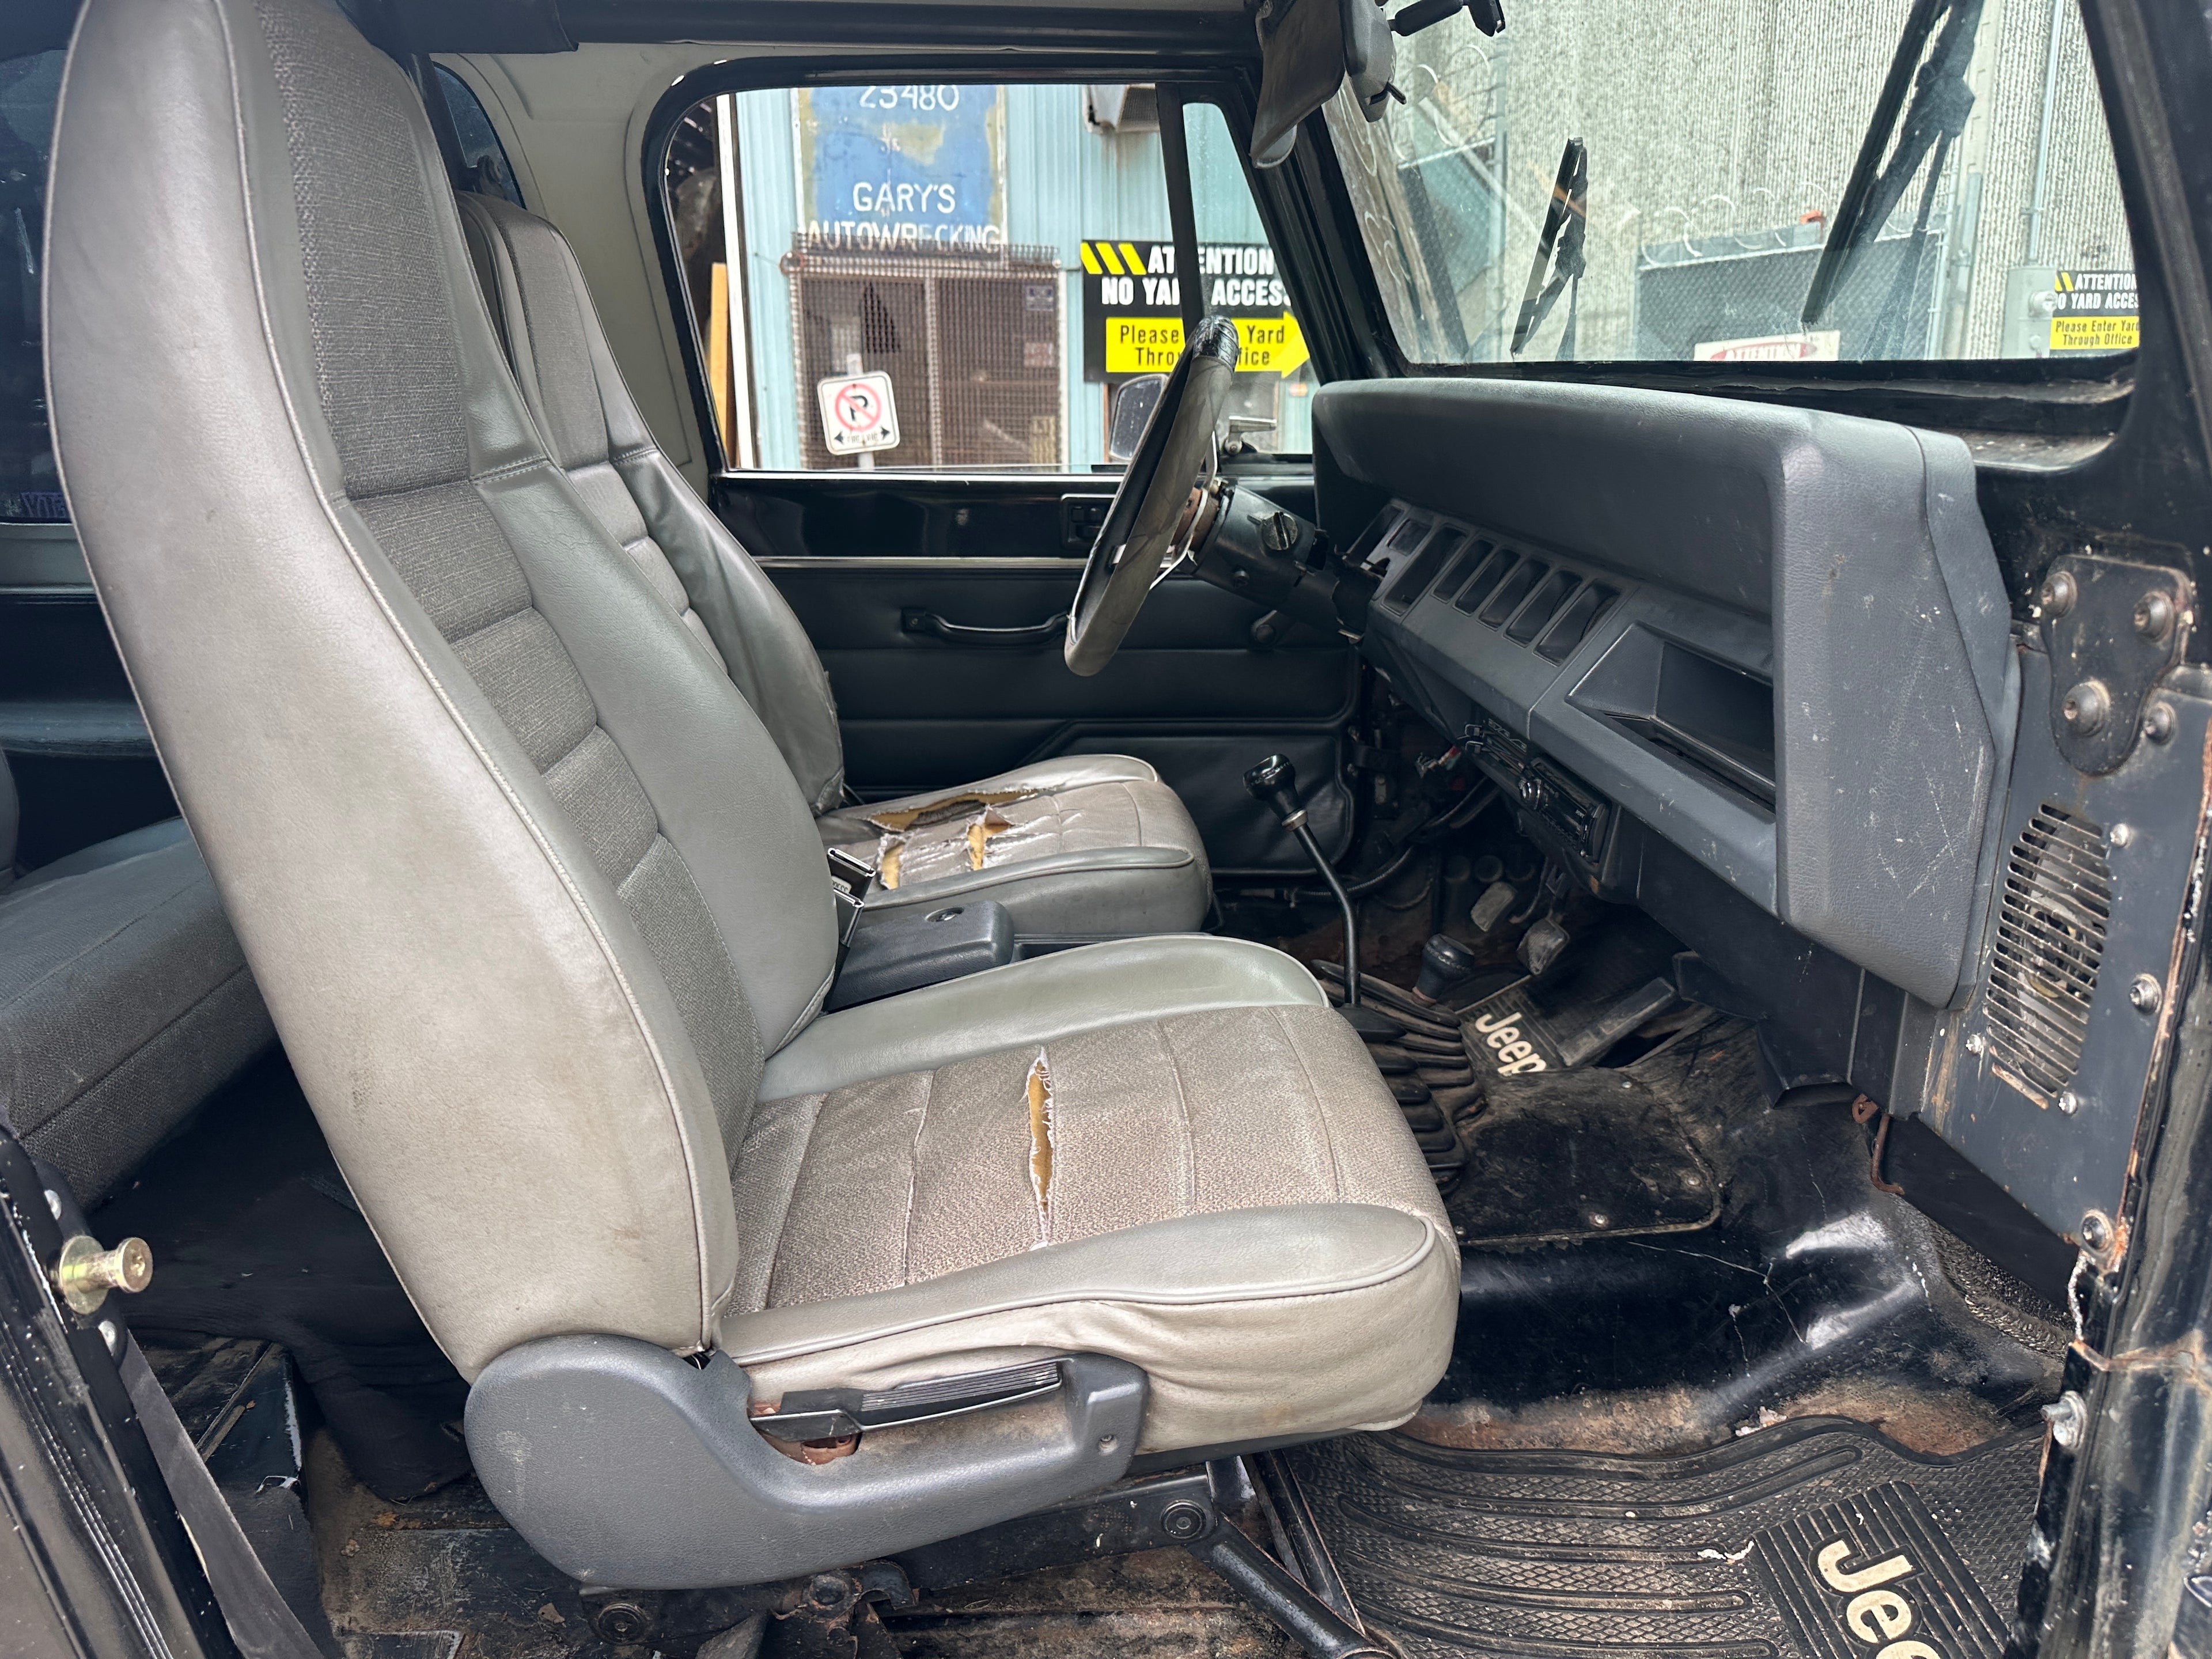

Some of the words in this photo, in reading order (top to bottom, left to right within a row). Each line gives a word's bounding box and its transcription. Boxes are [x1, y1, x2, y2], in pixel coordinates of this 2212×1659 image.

[853, 181, 956, 214] GARY'S
[1147, 245, 1274, 275] ATENTION
[1101, 277, 1134, 305] NO
[1142, 277, 1180, 305] YA
[2074, 273, 2137, 290] ATTENTION
[2057, 293, 2067, 309] O
[2071, 293, 2101, 309] YARD
[1120, 325, 1179, 344] Please
[1247, 325, 1284, 344] Yard
[2056, 321, 2087, 332] Please
[2092, 320, 2116, 332] Enter
[2063, 334, 2100, 347] Through
[2104, 333, 2132, 344] Office
[1135, 347, 1180, 366] Thro
[1238, 347, 1270, 365] fice
[1475, 1012, 1547, 1077] Jeep
